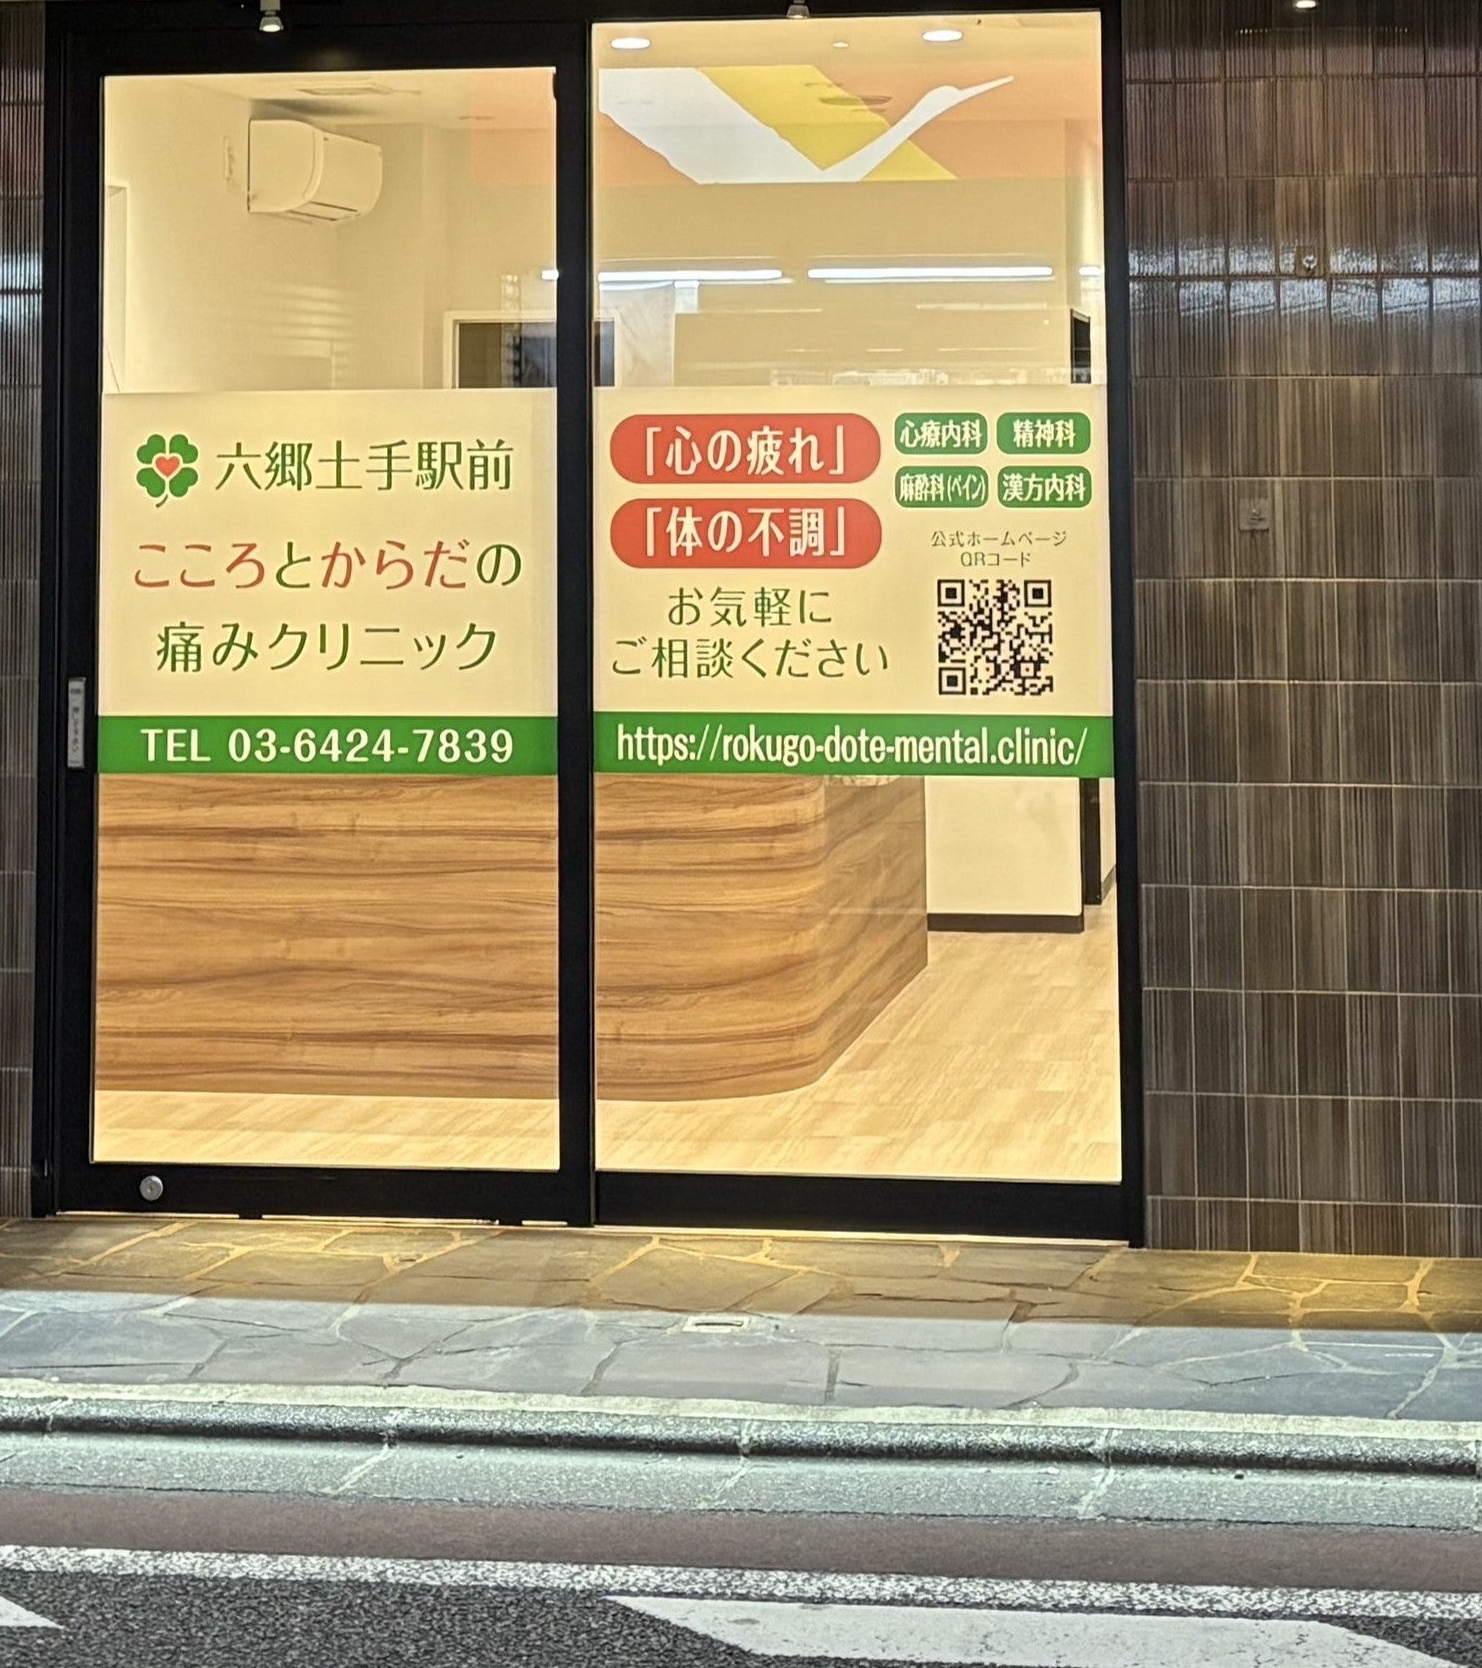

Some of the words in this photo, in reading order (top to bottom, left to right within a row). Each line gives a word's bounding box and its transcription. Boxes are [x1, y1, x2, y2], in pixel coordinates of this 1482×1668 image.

[645, 424, 845, 477] 「心の疲れ」
[900, 419, 982, 449] 心療内科
[1012, 419, 1076, 448] 精神科
[215, 438, 514, 492] 六郷土手駅前
[1002, 472, 1086, 503] 漢方内科
[645, 506, 845, 558] 「体の不調」
[931, 529, 1068, 549] 公式ホームページ
[134, 539, 523, 590] こころとからだの
[960, 550, 1032, 568] QRコード
[667, 586, 833, 627] お気軽に
[156, 620, 496, 673] 痛みクリニック
[611, 636, 889, 679] ご相談ください
[141, 729, 212, 763] TEL
[228, 727, 514, 764] 03-6424-7839
[617, 723, 1089, 768] https://rokugo-dote-mental.clinic/
